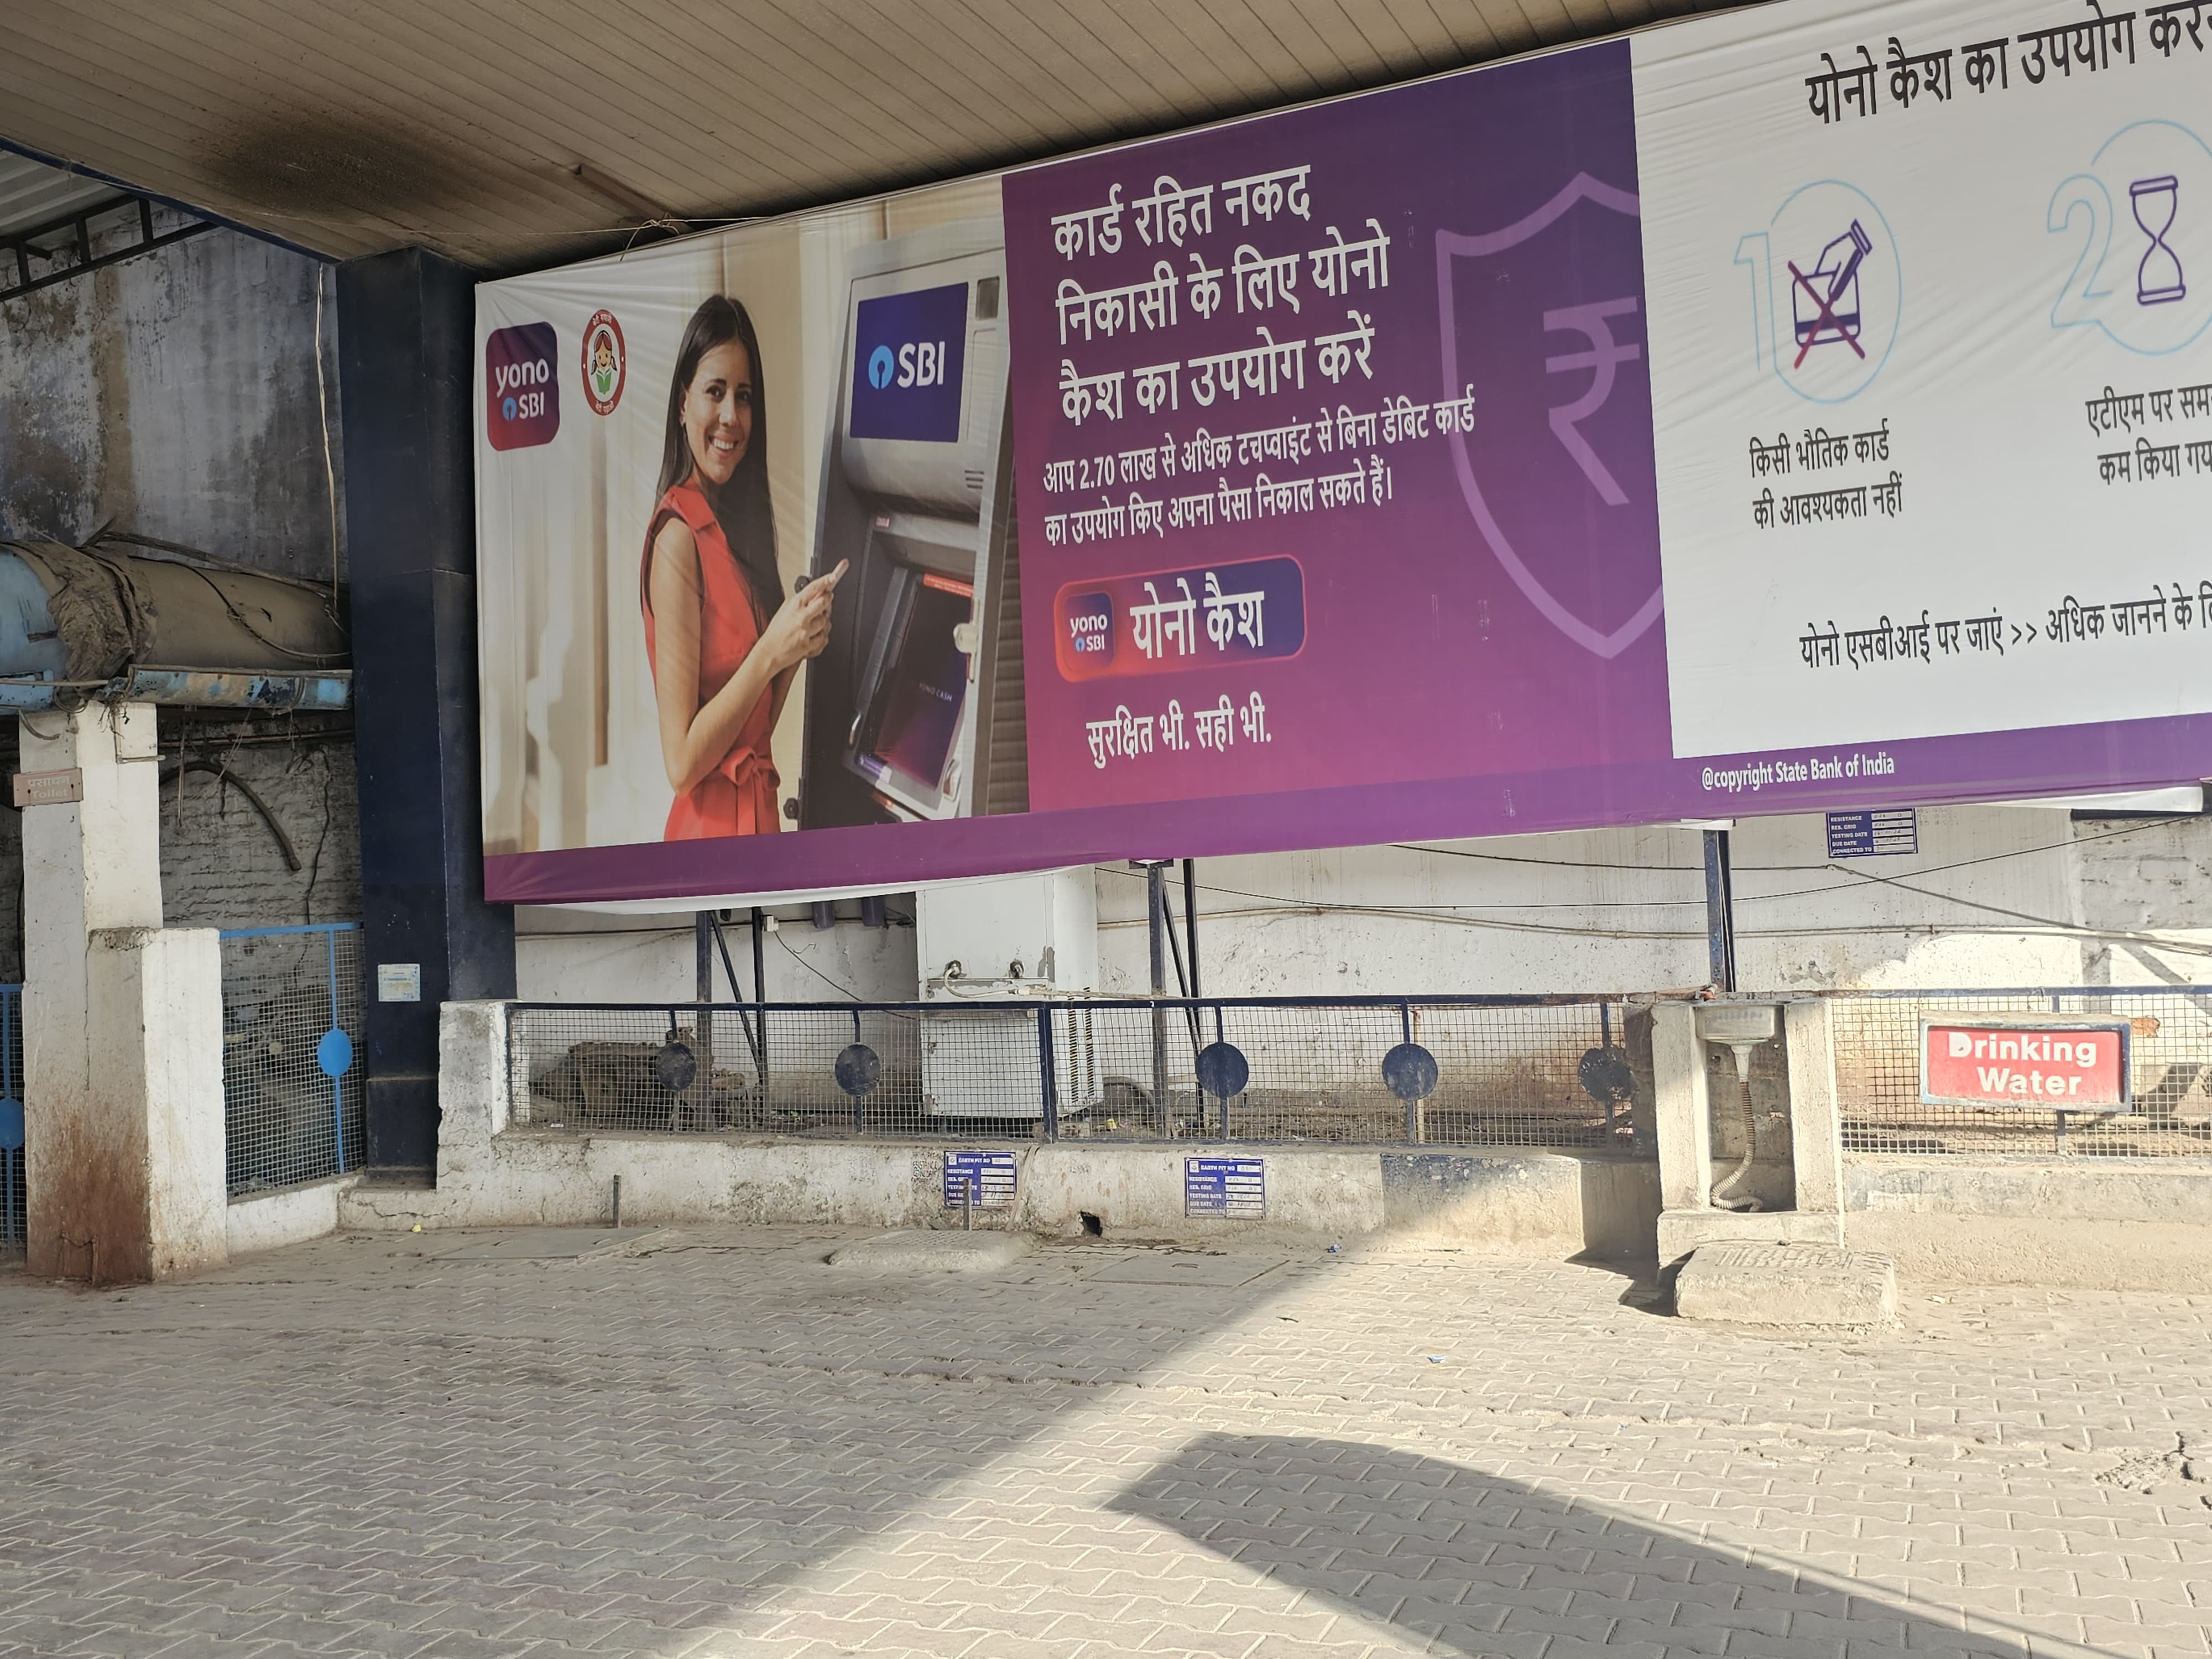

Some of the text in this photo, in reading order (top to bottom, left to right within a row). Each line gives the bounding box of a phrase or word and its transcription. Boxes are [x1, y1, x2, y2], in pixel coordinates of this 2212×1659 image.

[1805, 0, 2212, 124] योनो कैश का उपयोग कर
[1052, 165, 1311, 260] कार्ड रहित नकद
[1056, 218, 1390, 345] निकासी के लिए योनो
[495, 357, 549, 398] yono
[897, 341, 945, 388] SBI
[1059, 310, 1375, 426] कैश का उपयोग करें
[518, 394, 545, 419] SBI
[2085, 384, 2212, 437] एटीएम पर सम
[1044, 384, 1475, 493] आप 2.70 लाख से अधिक टचप्वाइंट से बिना डेबिट कार्ड
[1749, 418, 1890, 478] किसी भौतिक कार्ड
[2098, 437, 2212, 486] कम किया गय
[1045, 515, 1067, 546] का
[1071, 496, 1124, 542] उपयोग
[1130, 493, 1164, 539] किए
[1168, 493, 1213, 533] अपना
[1218, 478, 1251, 521] पैसा
[1256, 473, 1313, 517] निकाल
[1319, 460, 1365, 509] सकते
[1752, 472, 1903, 529] की आवश्यकता नहीं
[1070, 614, 1108, 639] yono
[1130, 572, 1265, 659] योनो कैश
[1799, 620, 1839, 668] योनो
[1845, 609, 1930, 670] एसबीआई
[1936, 620, 1960, 655] पर
[1966, 607, 2004, 655] जाएं
[2045, 595, 2104, 643] अधिक
[2110, 585, 2166, 637] जानने
[2172, 583, 2193, 630] के
[1087, 634, 1105, 652] SBI
[1086, 691, 1272, 769] सुरक्षित भी. सही भी.
[27, 775, 70, 788] प्रसाधन
[31, 789, 69, 799] Toilet
[1702, 751, 1895, 792] @copyright State Bank of India
[1948, 1031, 2097, 1068] Drinking
[1977, 1067, 2083, 1095] Water
